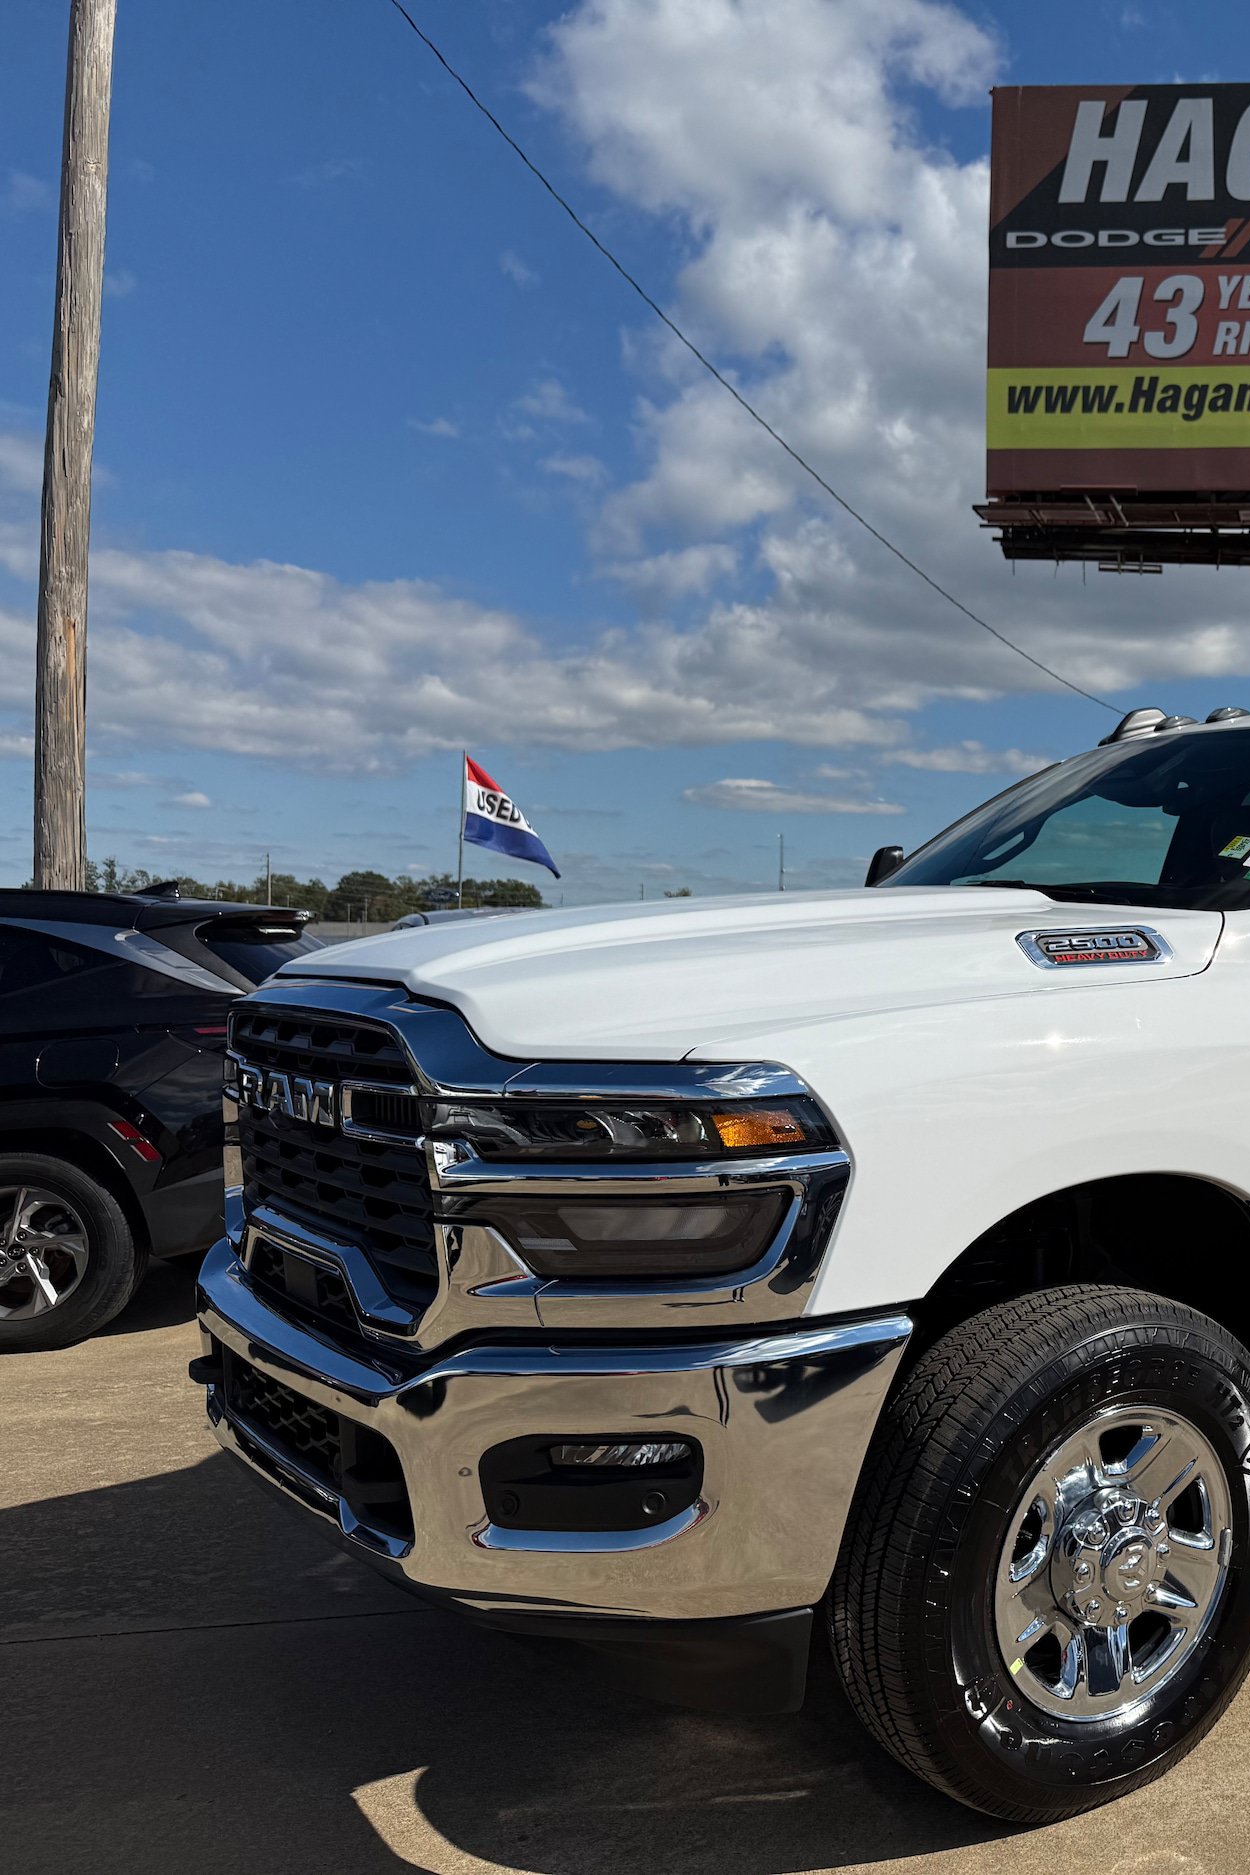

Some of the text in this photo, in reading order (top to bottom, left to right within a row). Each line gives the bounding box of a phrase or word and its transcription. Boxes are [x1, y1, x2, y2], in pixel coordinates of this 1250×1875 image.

[1006, 227, 1227, 248] DODGE
[1083, 274, 1205, 359] 43
[477, 788, 521, 823] USED
[1045, 936, 1142, 951] 2500
[1055, 950, 1148, 963] HEAVY DUTY
[239, 1061, 335, 1127] RAM
[1208, 1380, 1246, 1432] HT2
